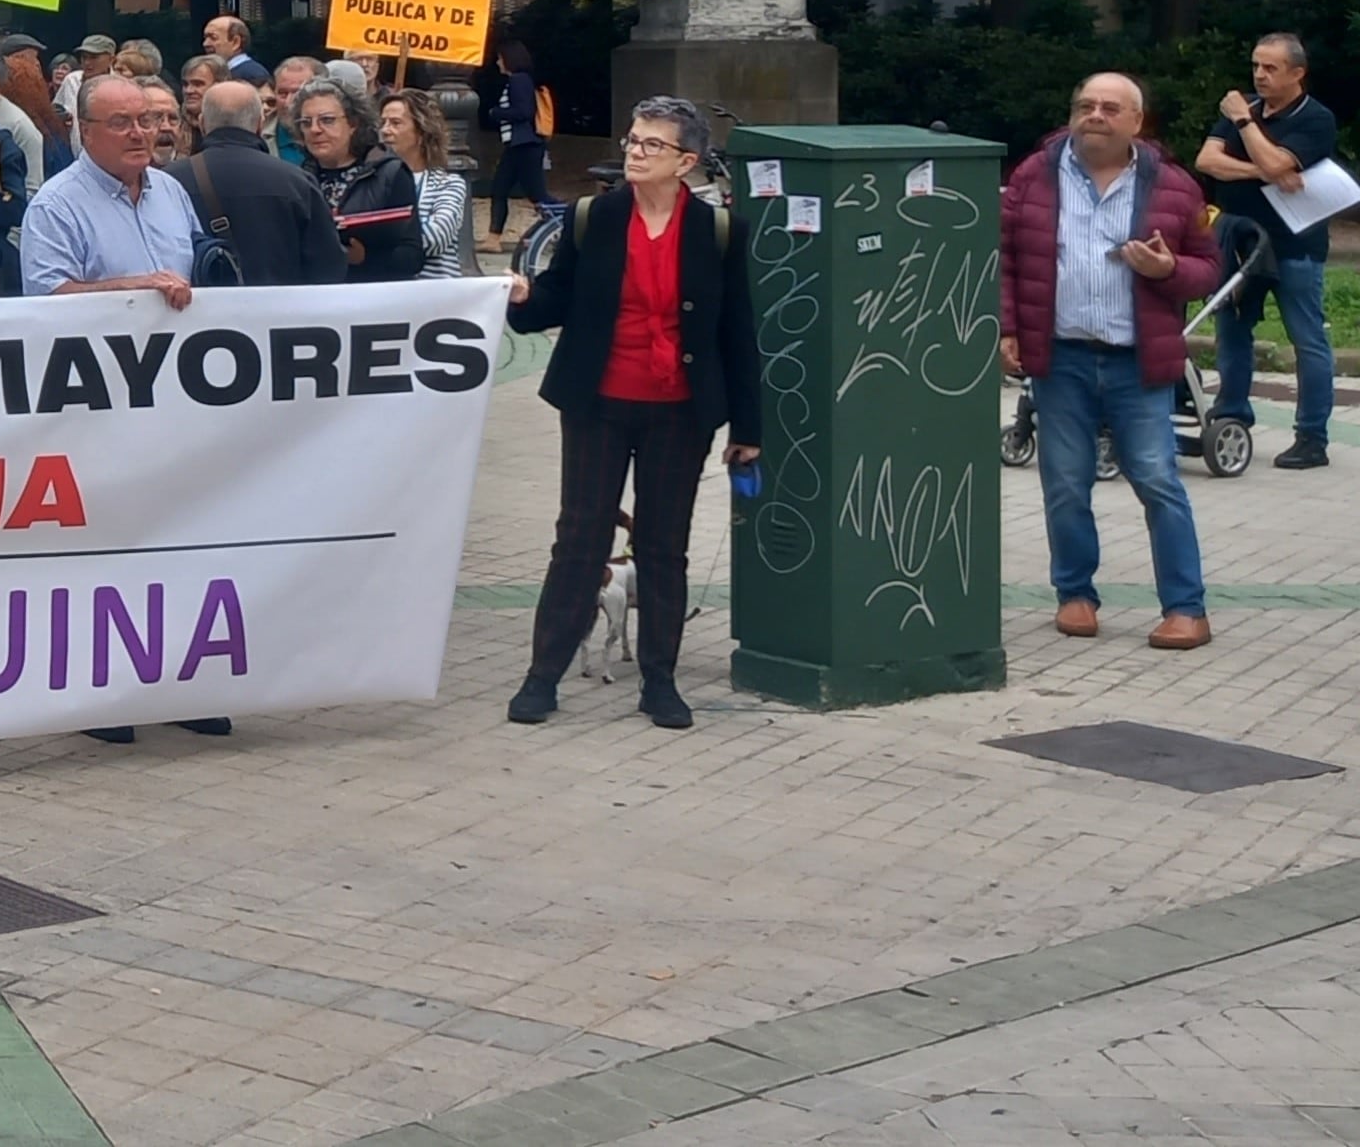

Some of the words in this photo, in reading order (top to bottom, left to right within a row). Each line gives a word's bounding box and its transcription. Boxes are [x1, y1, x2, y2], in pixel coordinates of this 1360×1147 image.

[433, 7, 445, 22] Y
[450, 9, 476, 26] DE
[364, 28, 449, 52] CALDAD
